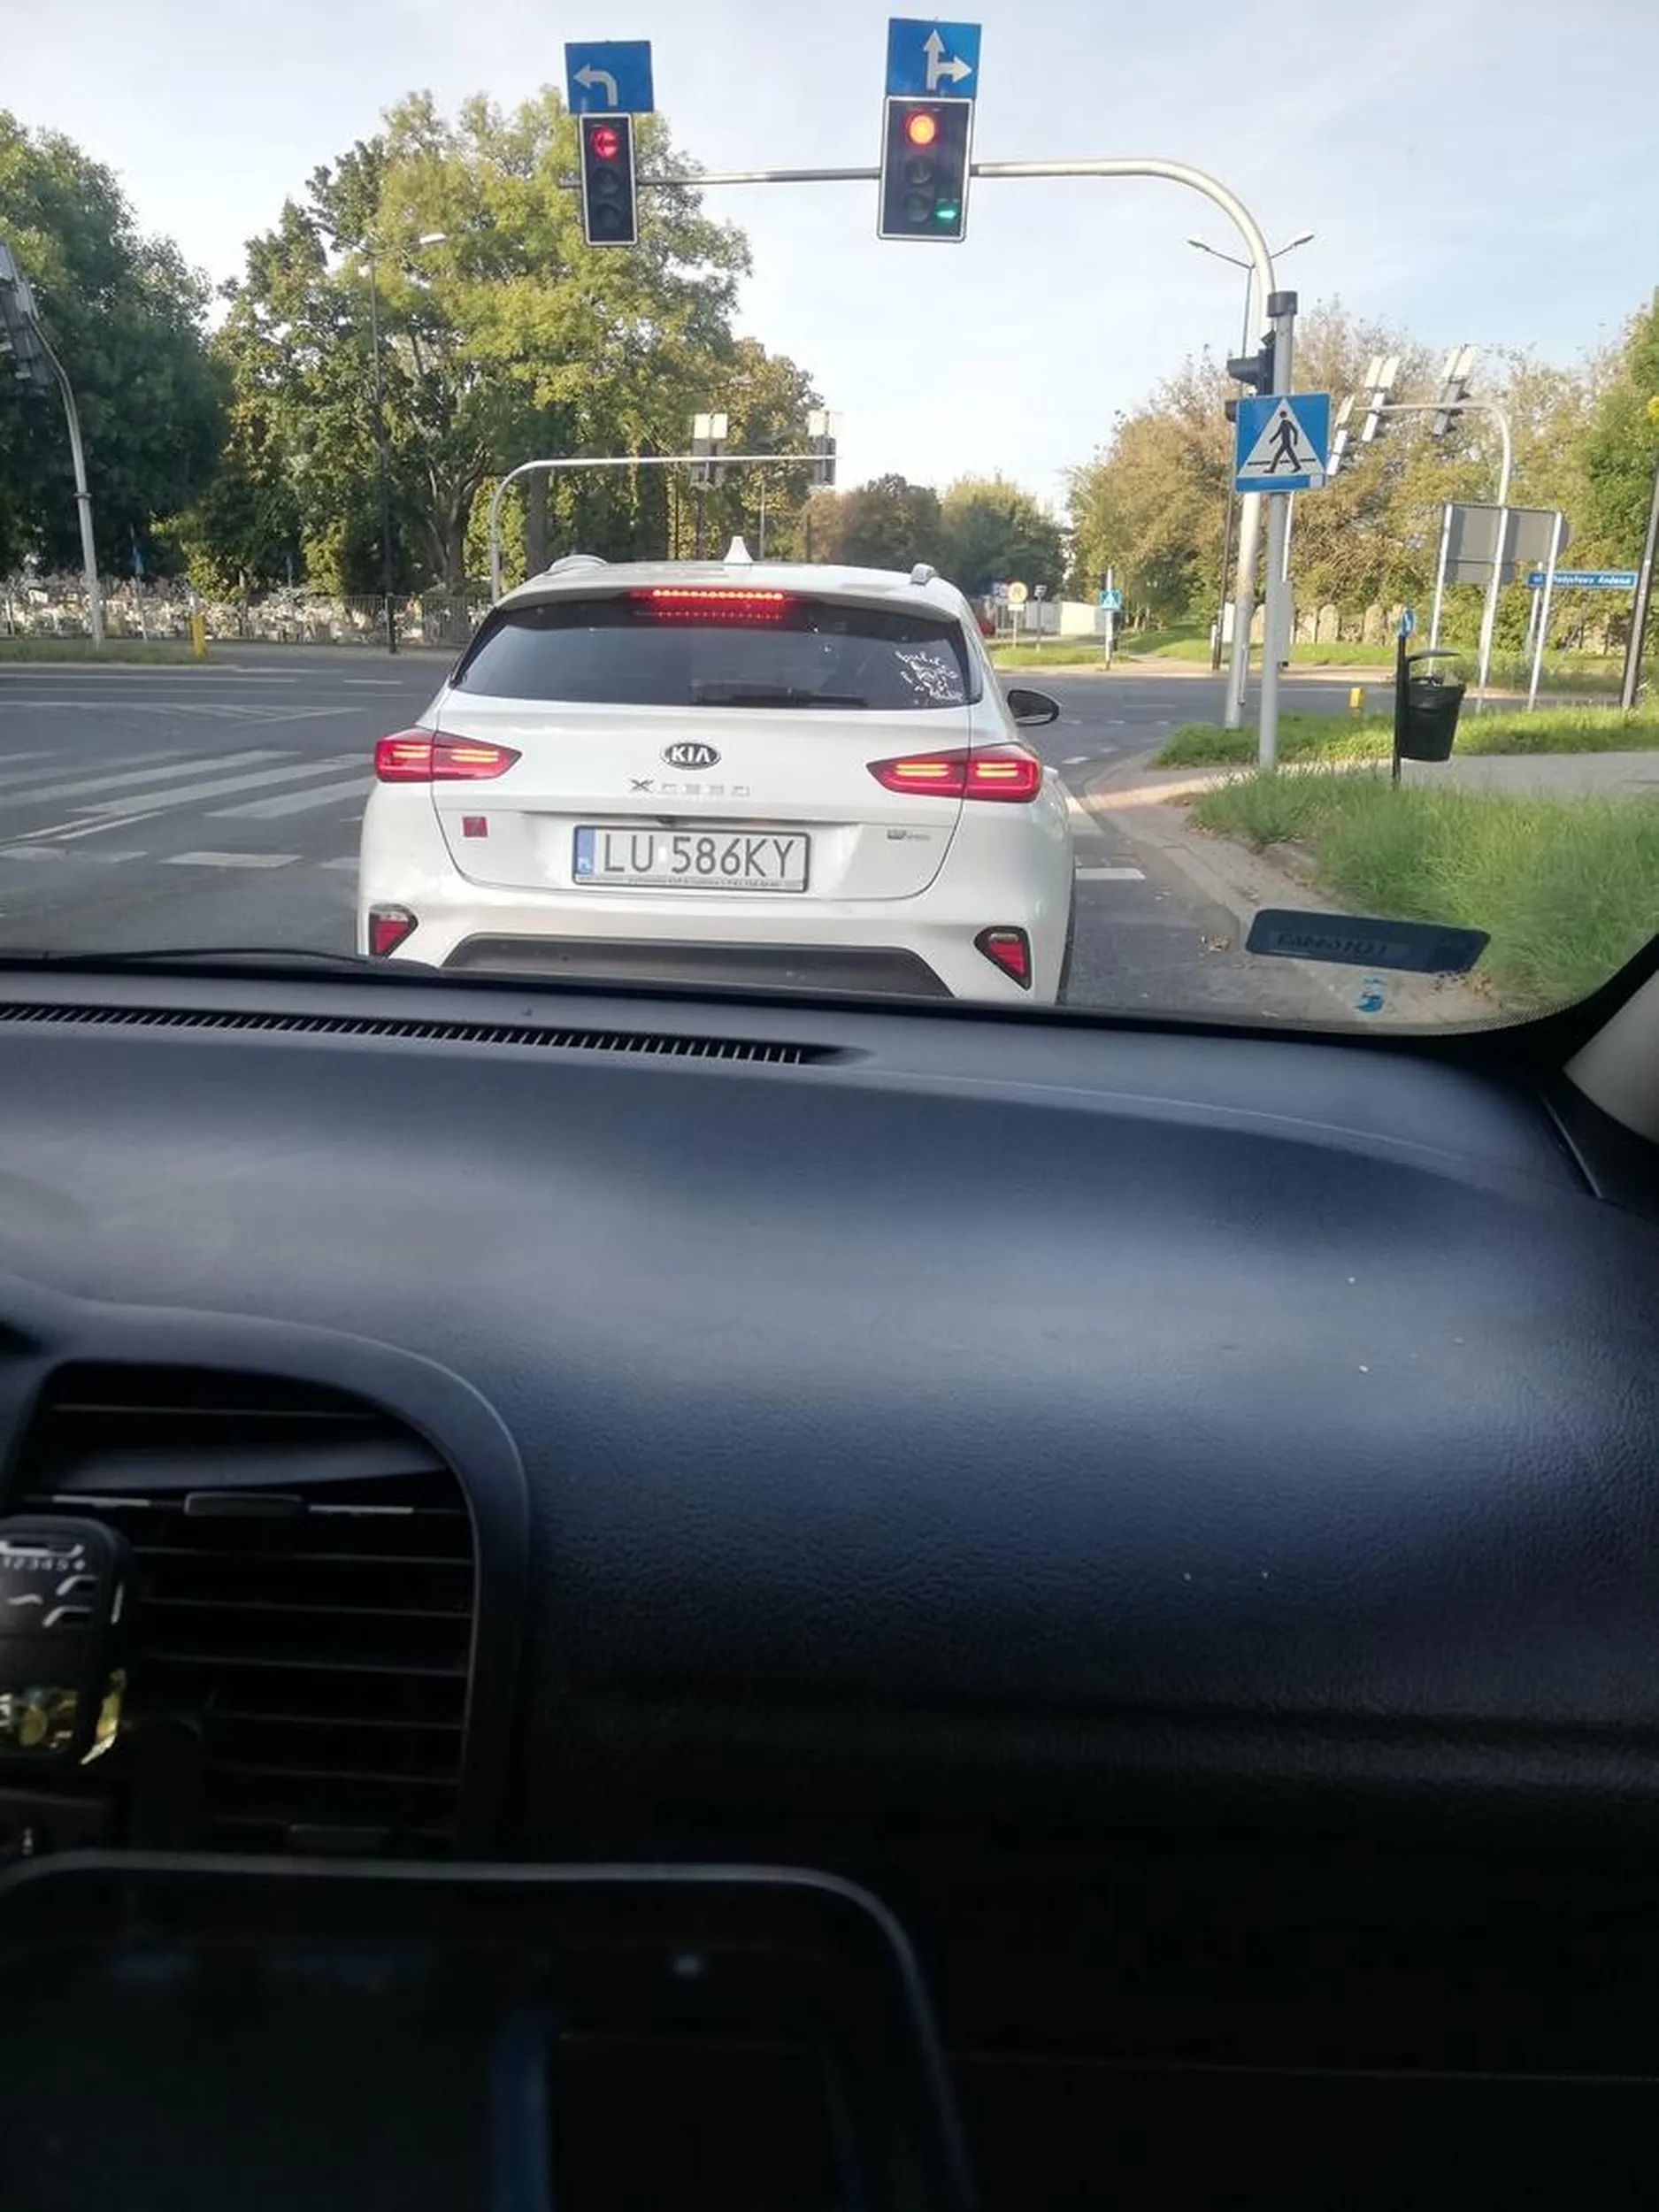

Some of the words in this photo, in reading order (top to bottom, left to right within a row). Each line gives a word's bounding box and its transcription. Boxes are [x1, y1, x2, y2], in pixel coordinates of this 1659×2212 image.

[671, 746, 710, 763] KIA
[604, 833, 654, 872] LU
[672, 835, 795, 878] 586KY
